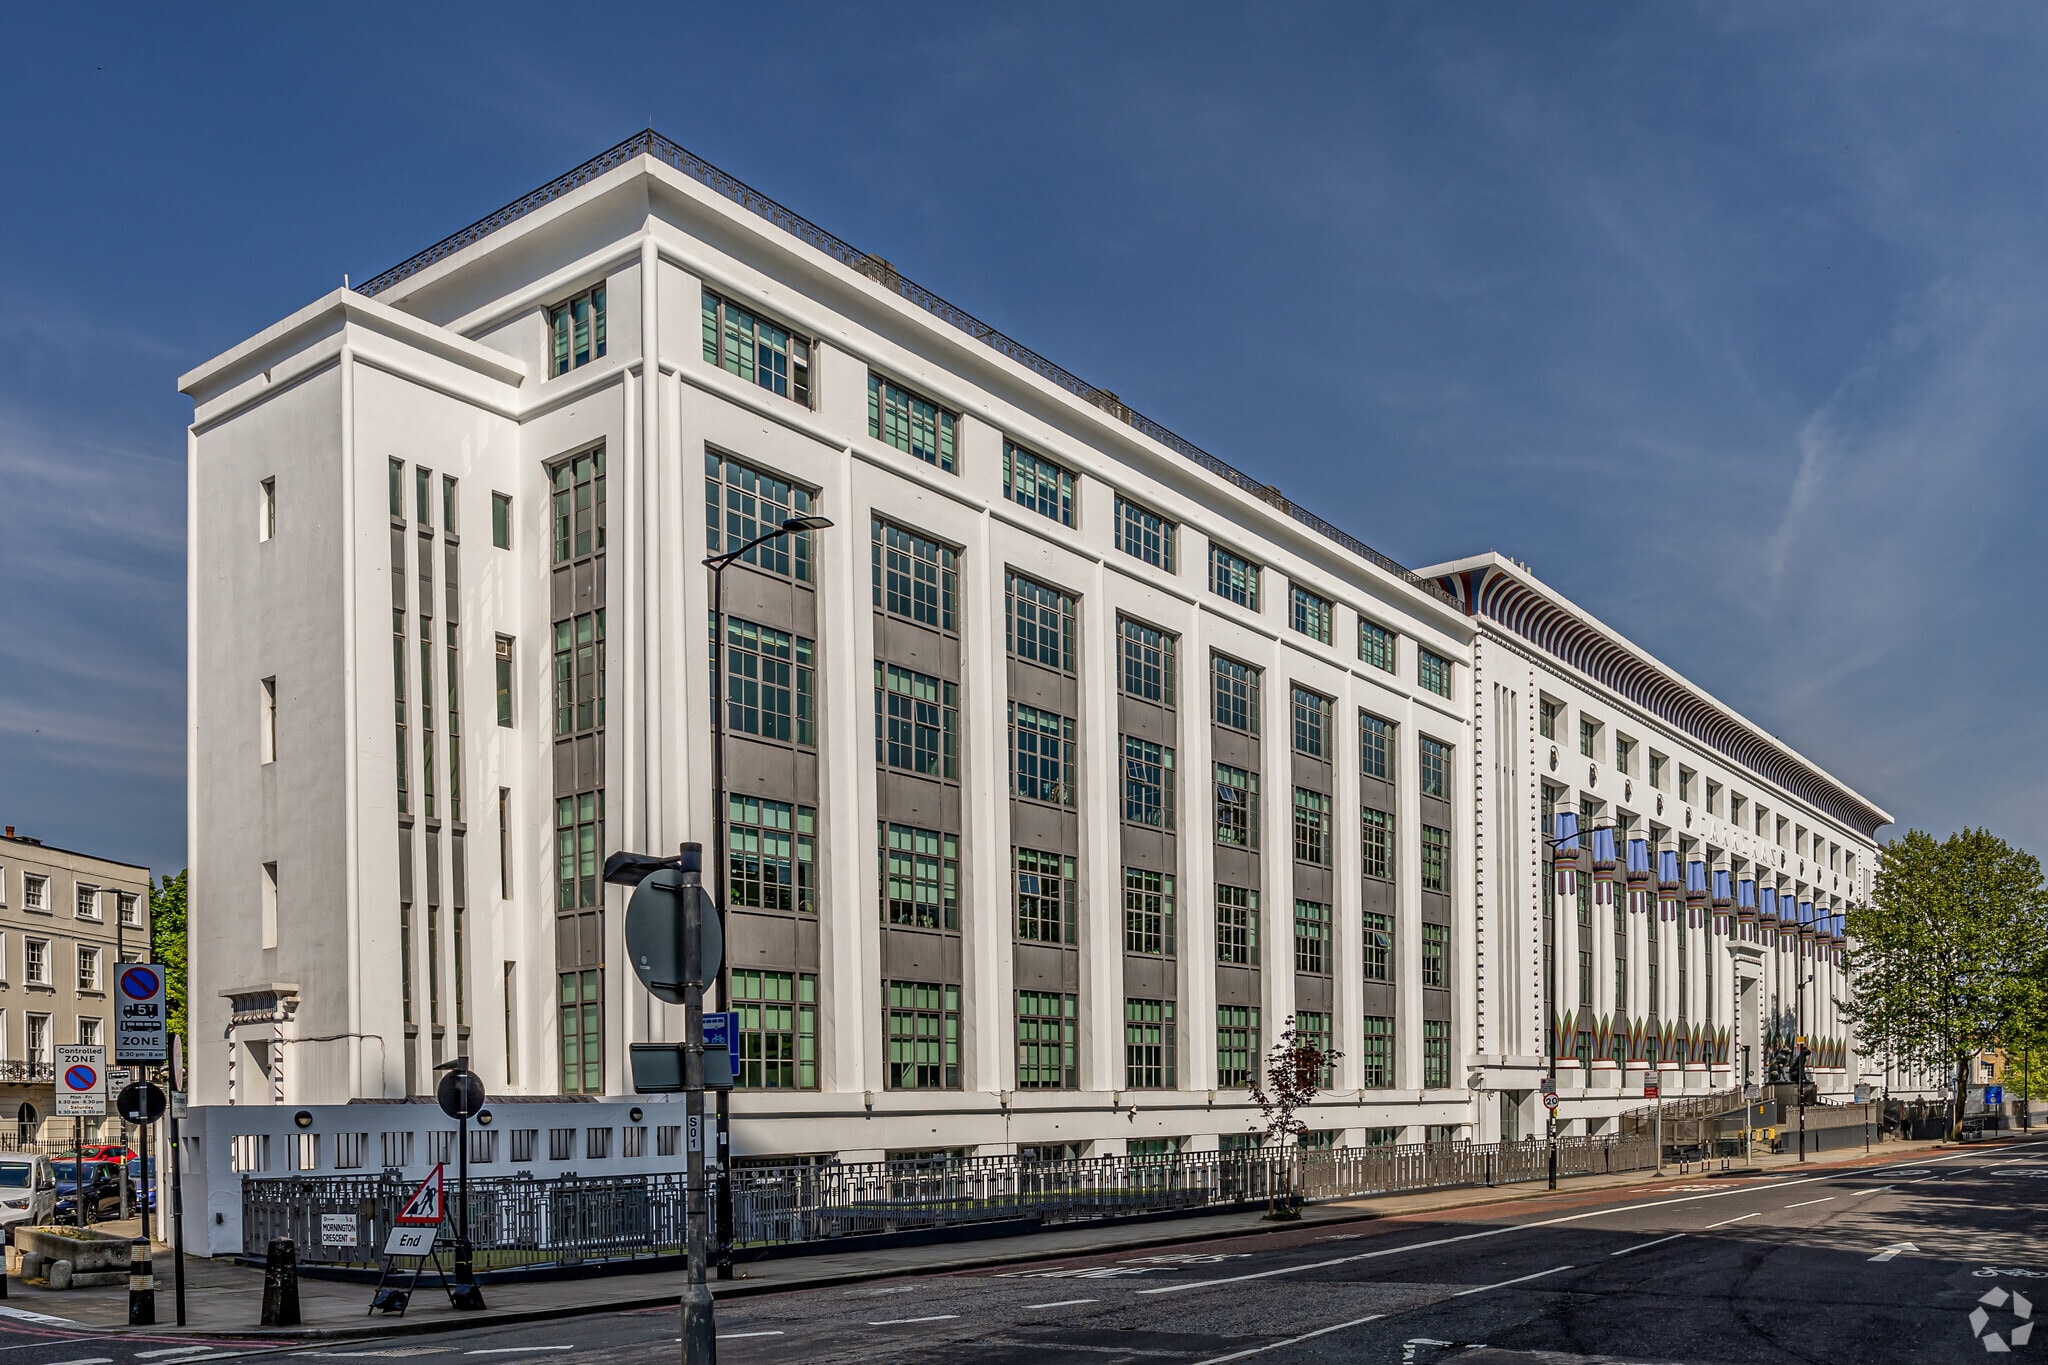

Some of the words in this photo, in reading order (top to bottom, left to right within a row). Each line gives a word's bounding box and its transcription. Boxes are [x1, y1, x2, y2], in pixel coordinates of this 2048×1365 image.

[122, 1036, 159, 1046] ZONE
[58, 1047, 102, 1055] Controlled
[64, 1055, 96, 1063] ZONE
[1546, 1097, 1558, 1105] 20
[323, 1224, 355, 1232] MORNINGTON
[323, 1234, 348, 1242] CRESCENT
[400, 1234, 421, 1247] End
